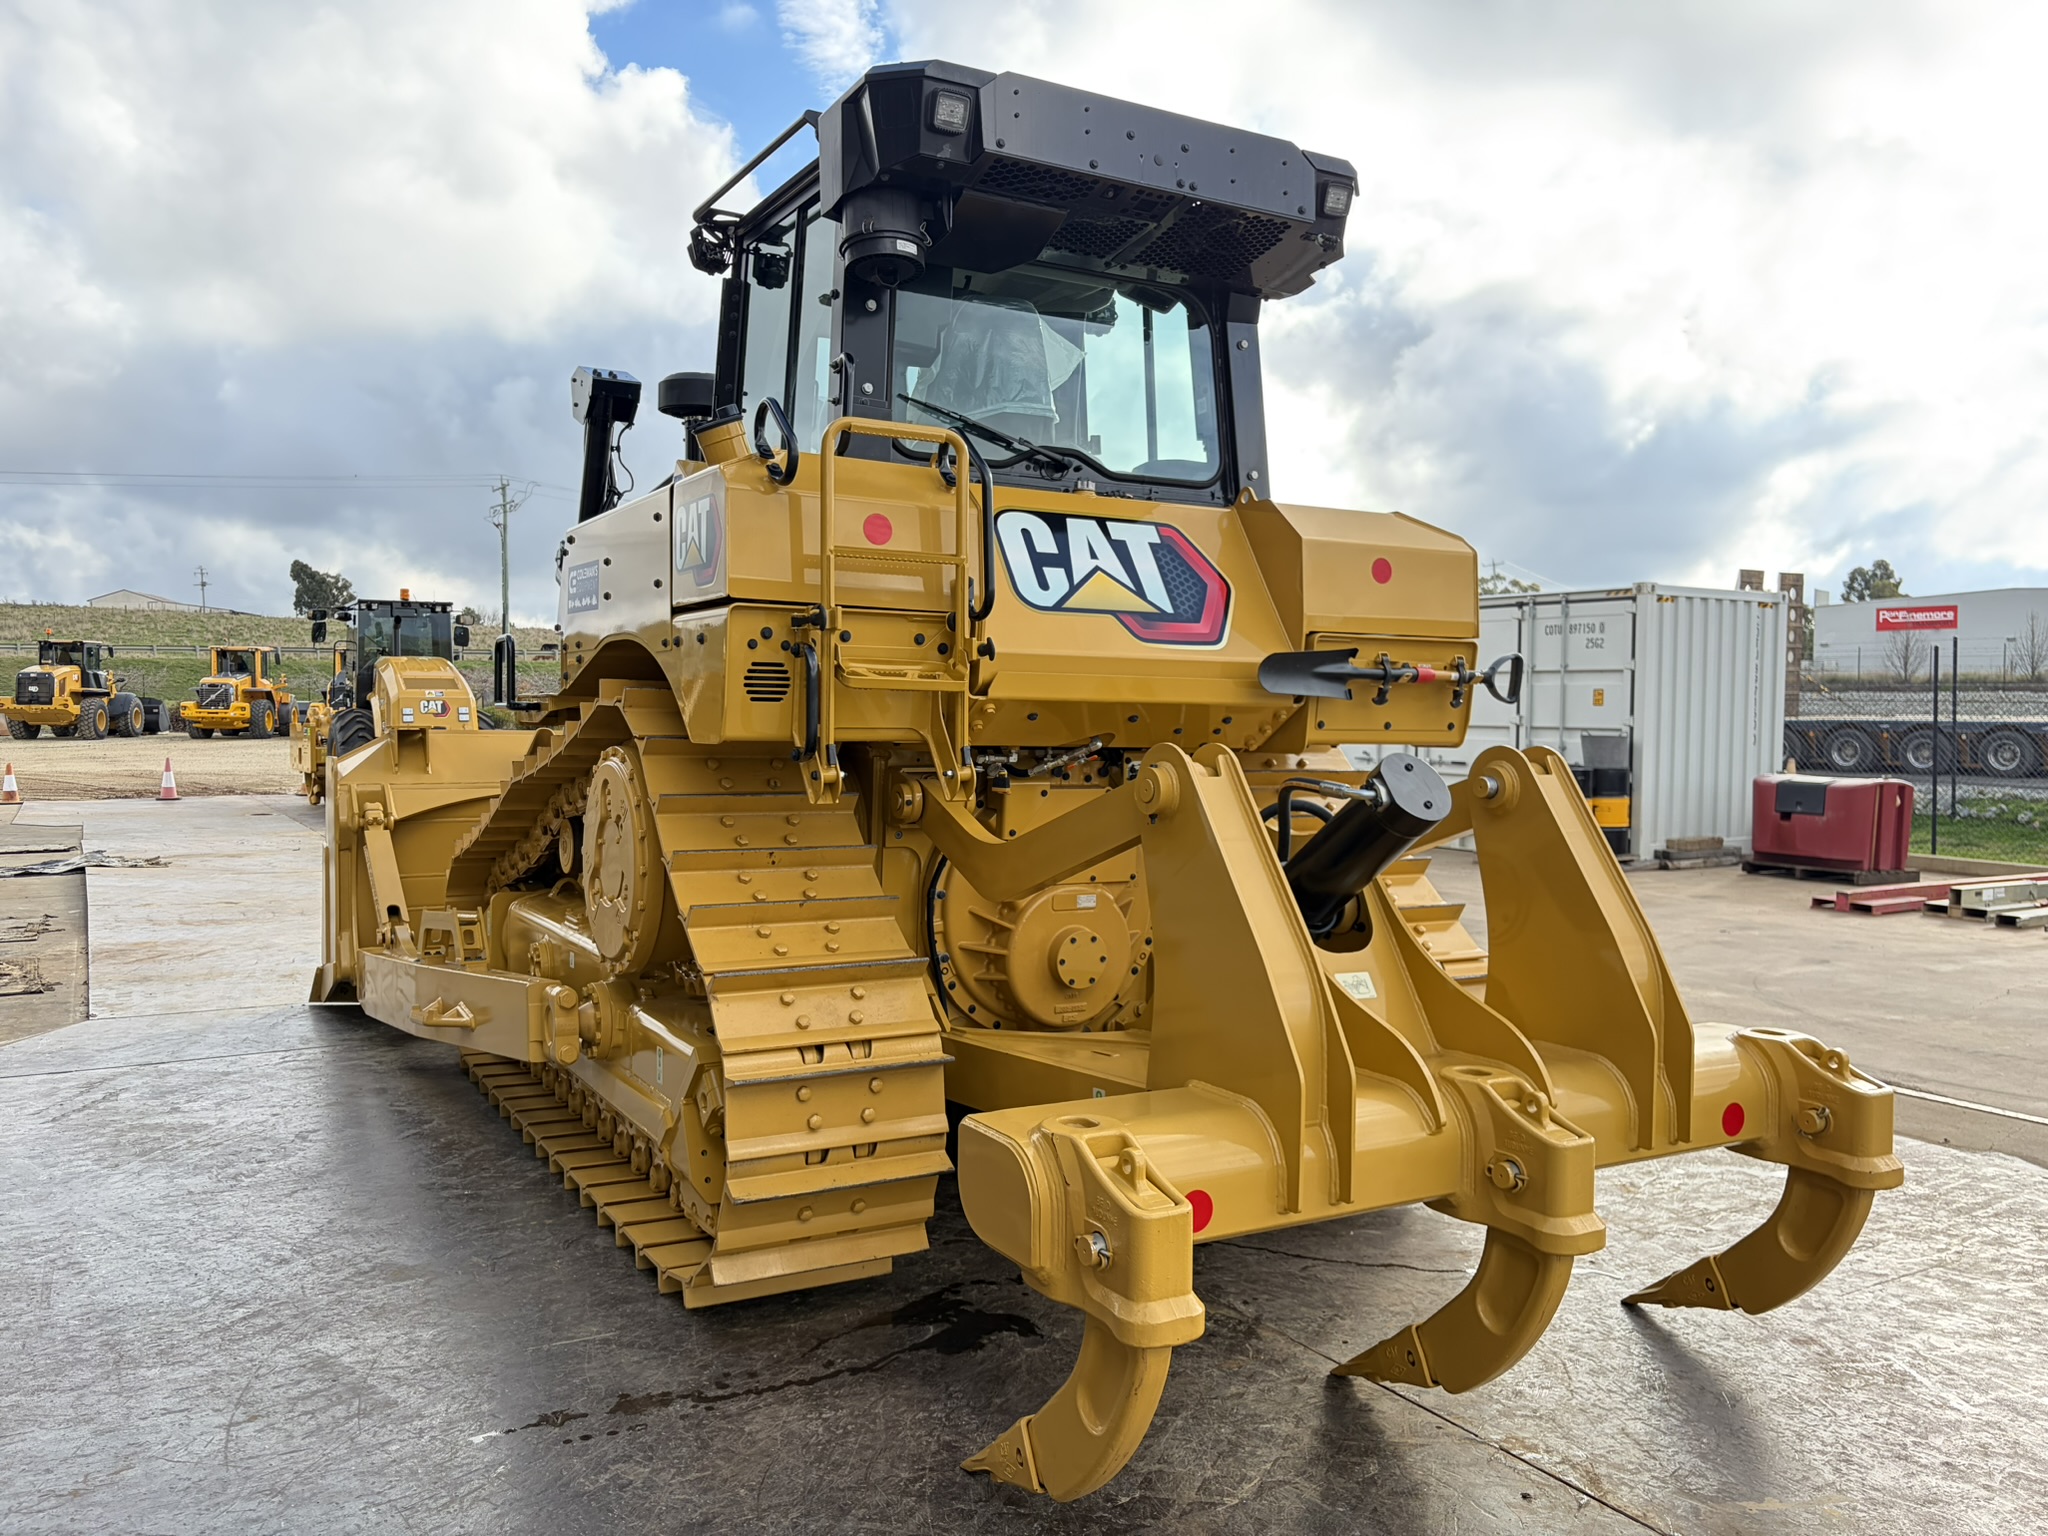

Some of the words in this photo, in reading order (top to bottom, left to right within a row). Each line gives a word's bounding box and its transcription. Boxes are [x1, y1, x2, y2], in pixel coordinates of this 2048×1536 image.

[676, 497, 710, 571] CAT
[997, 511, 1174, 614] CAT
[1544, 624, 1563, 636] COTU
[1568, 622, 1596, 635] 897150
[420, 700, 443, 714] CAT
